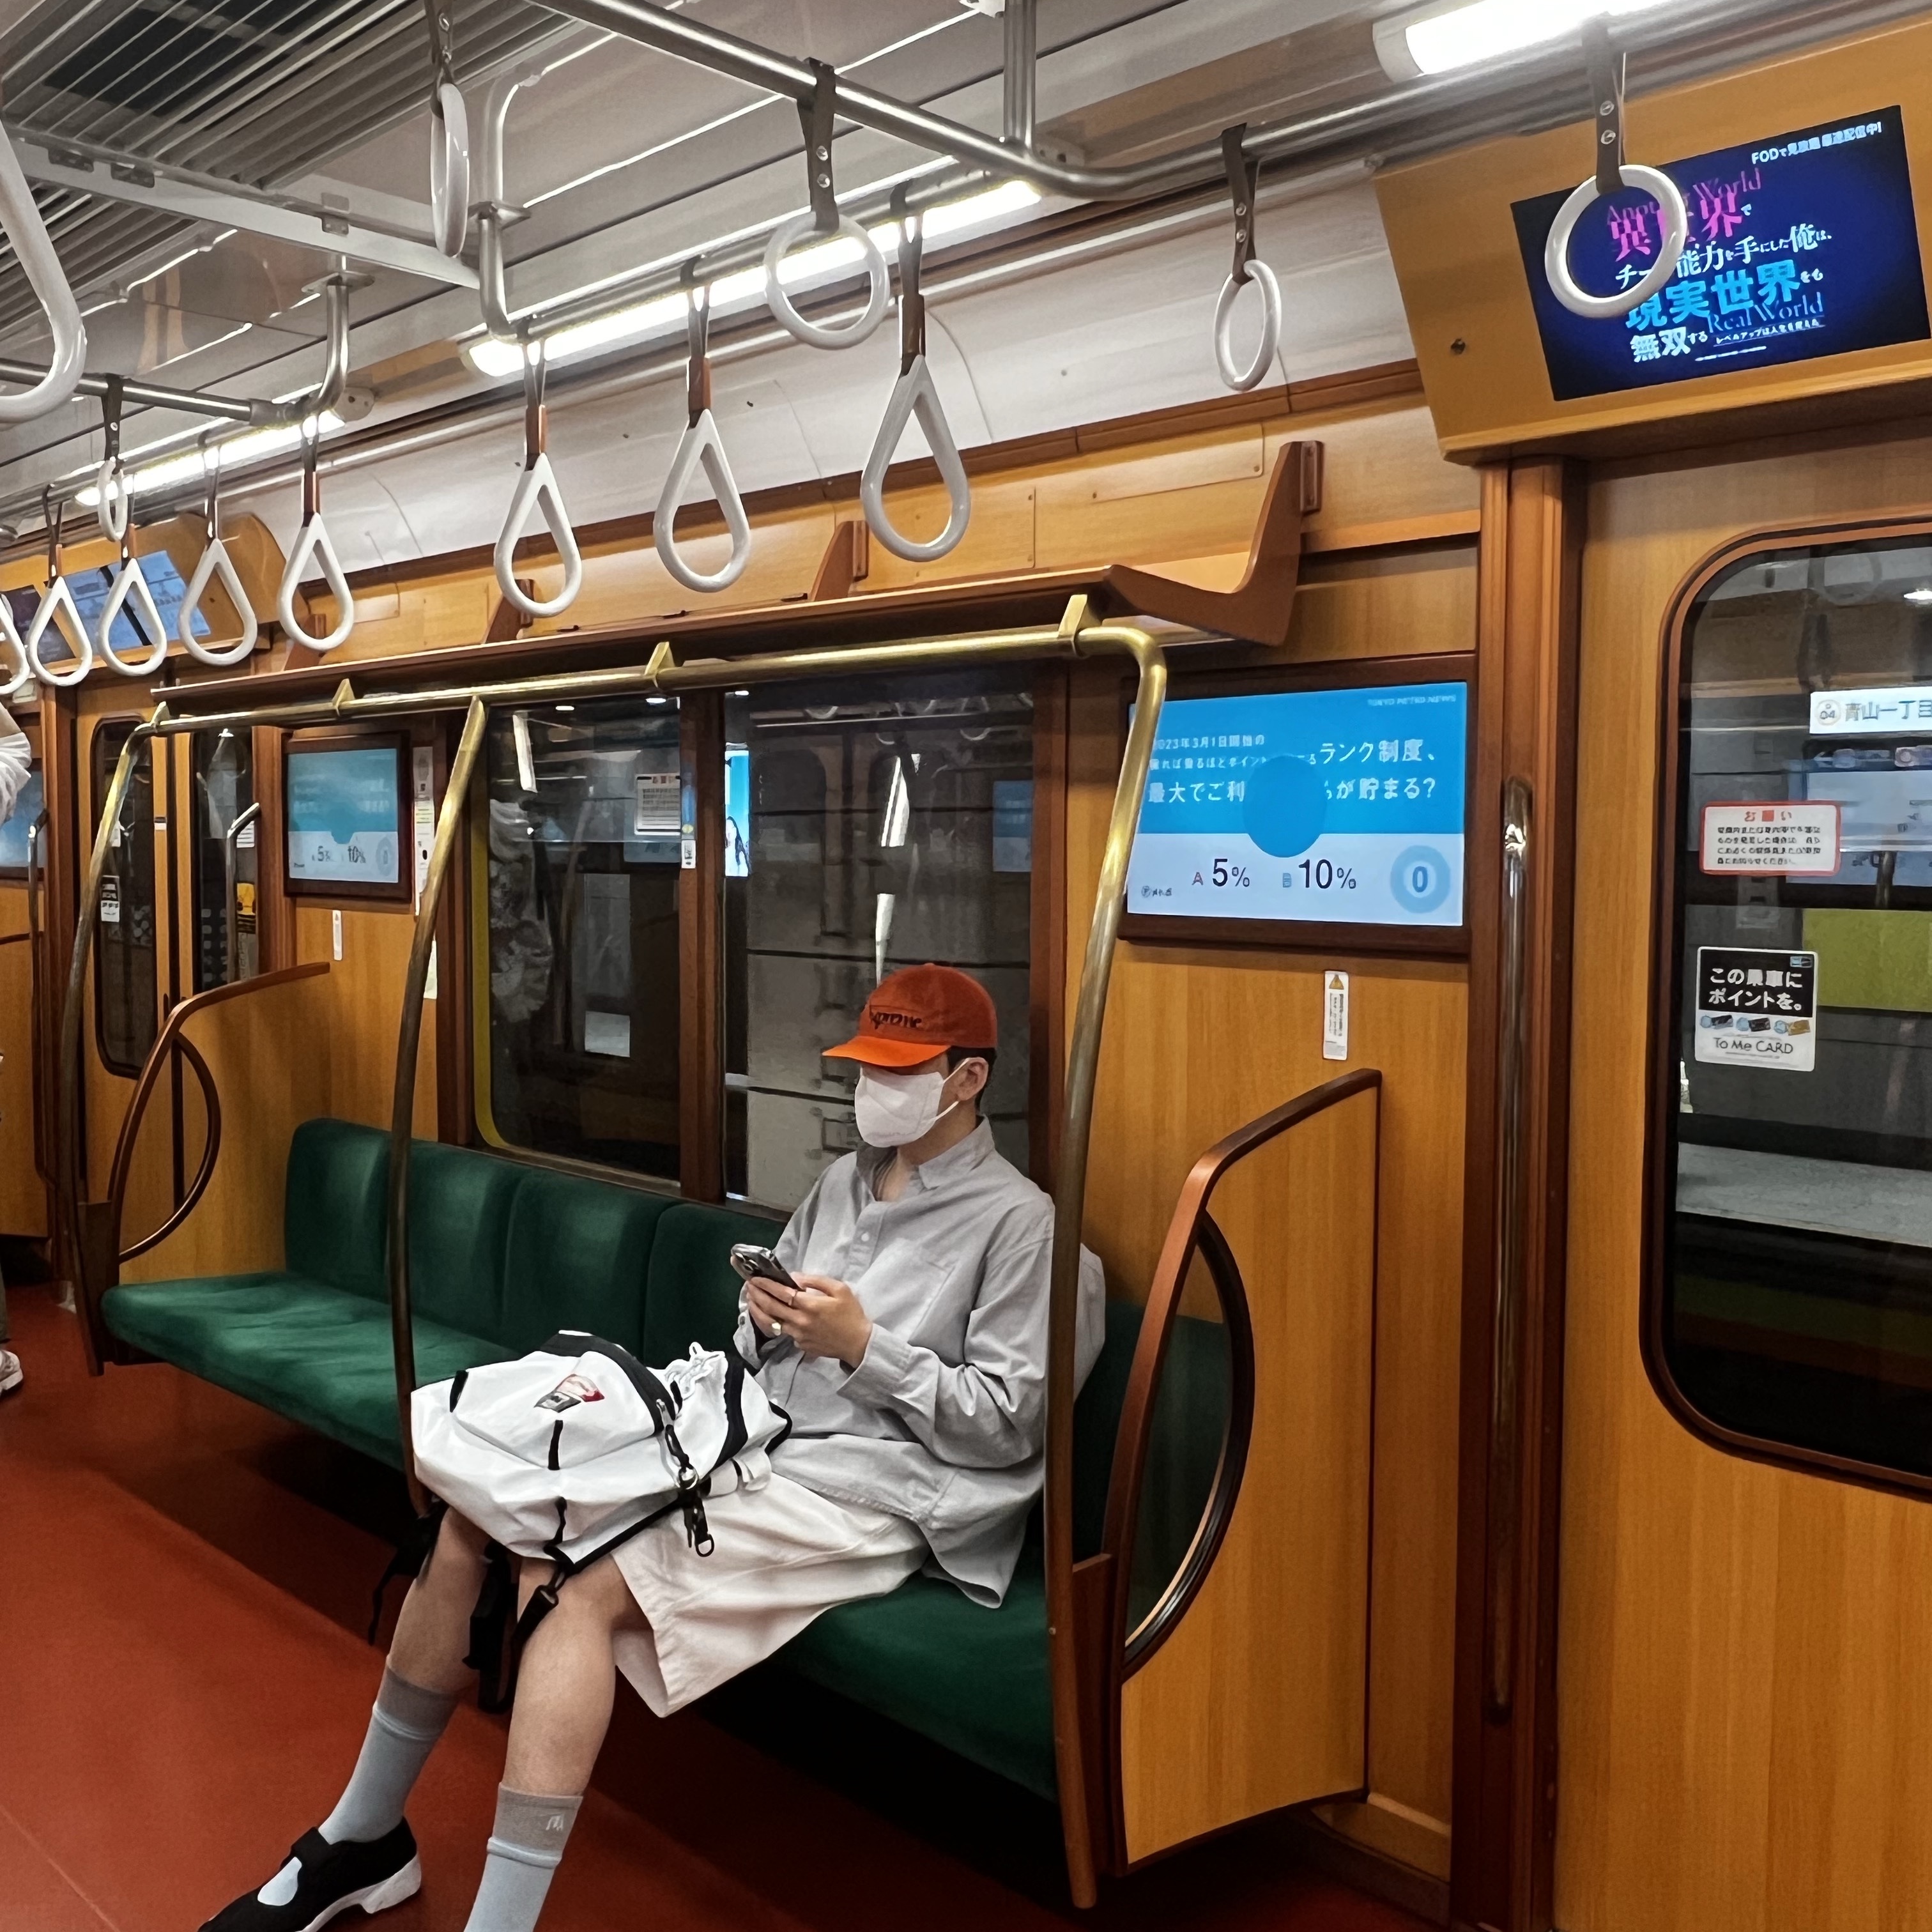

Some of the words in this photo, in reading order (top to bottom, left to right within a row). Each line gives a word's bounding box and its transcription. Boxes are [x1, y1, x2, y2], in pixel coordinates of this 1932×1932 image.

[1845, 701, 1932, 722] 青山一丁目
[1744, 809, 1792, 822] おい
[1212, 858, 1250, 887] 5%
[1298, 859, 1356, 889] 10%
[1413, 866, 1429, 893] 0
[1713, 1038, 1728, 1049] To
[1731, 1040, 1752, 1050] Me
[1756, 1040, 1793, 1054] CARD
